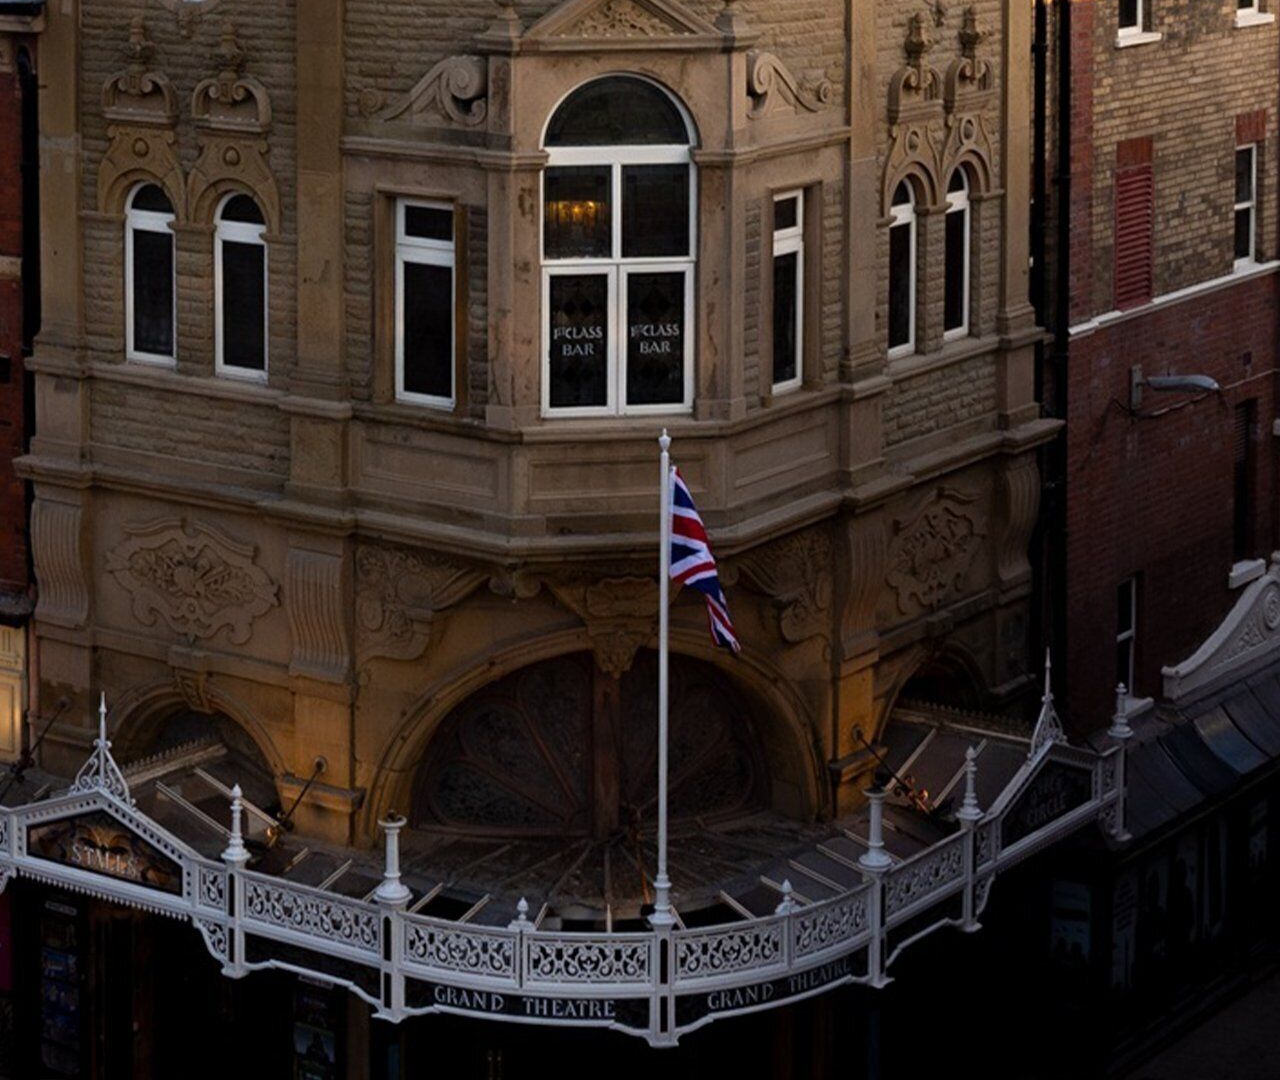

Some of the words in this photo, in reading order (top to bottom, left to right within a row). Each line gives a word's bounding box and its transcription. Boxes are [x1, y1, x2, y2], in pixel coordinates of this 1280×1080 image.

[565, 325, 603, 339] CLASS
[642, 323, 680, 337] CLASS
[561, 342, 595, 356] BAR
[639, 340, 671, 354] BAR
[73, 843, 138, 878] STALLS
[707, 982, 775, 1010] GRAND
[787, 959, 851, 993] THEATRE
[433, 985, 505, 1011] GRAND
[521, 997, 616, 1017] THEATRE
